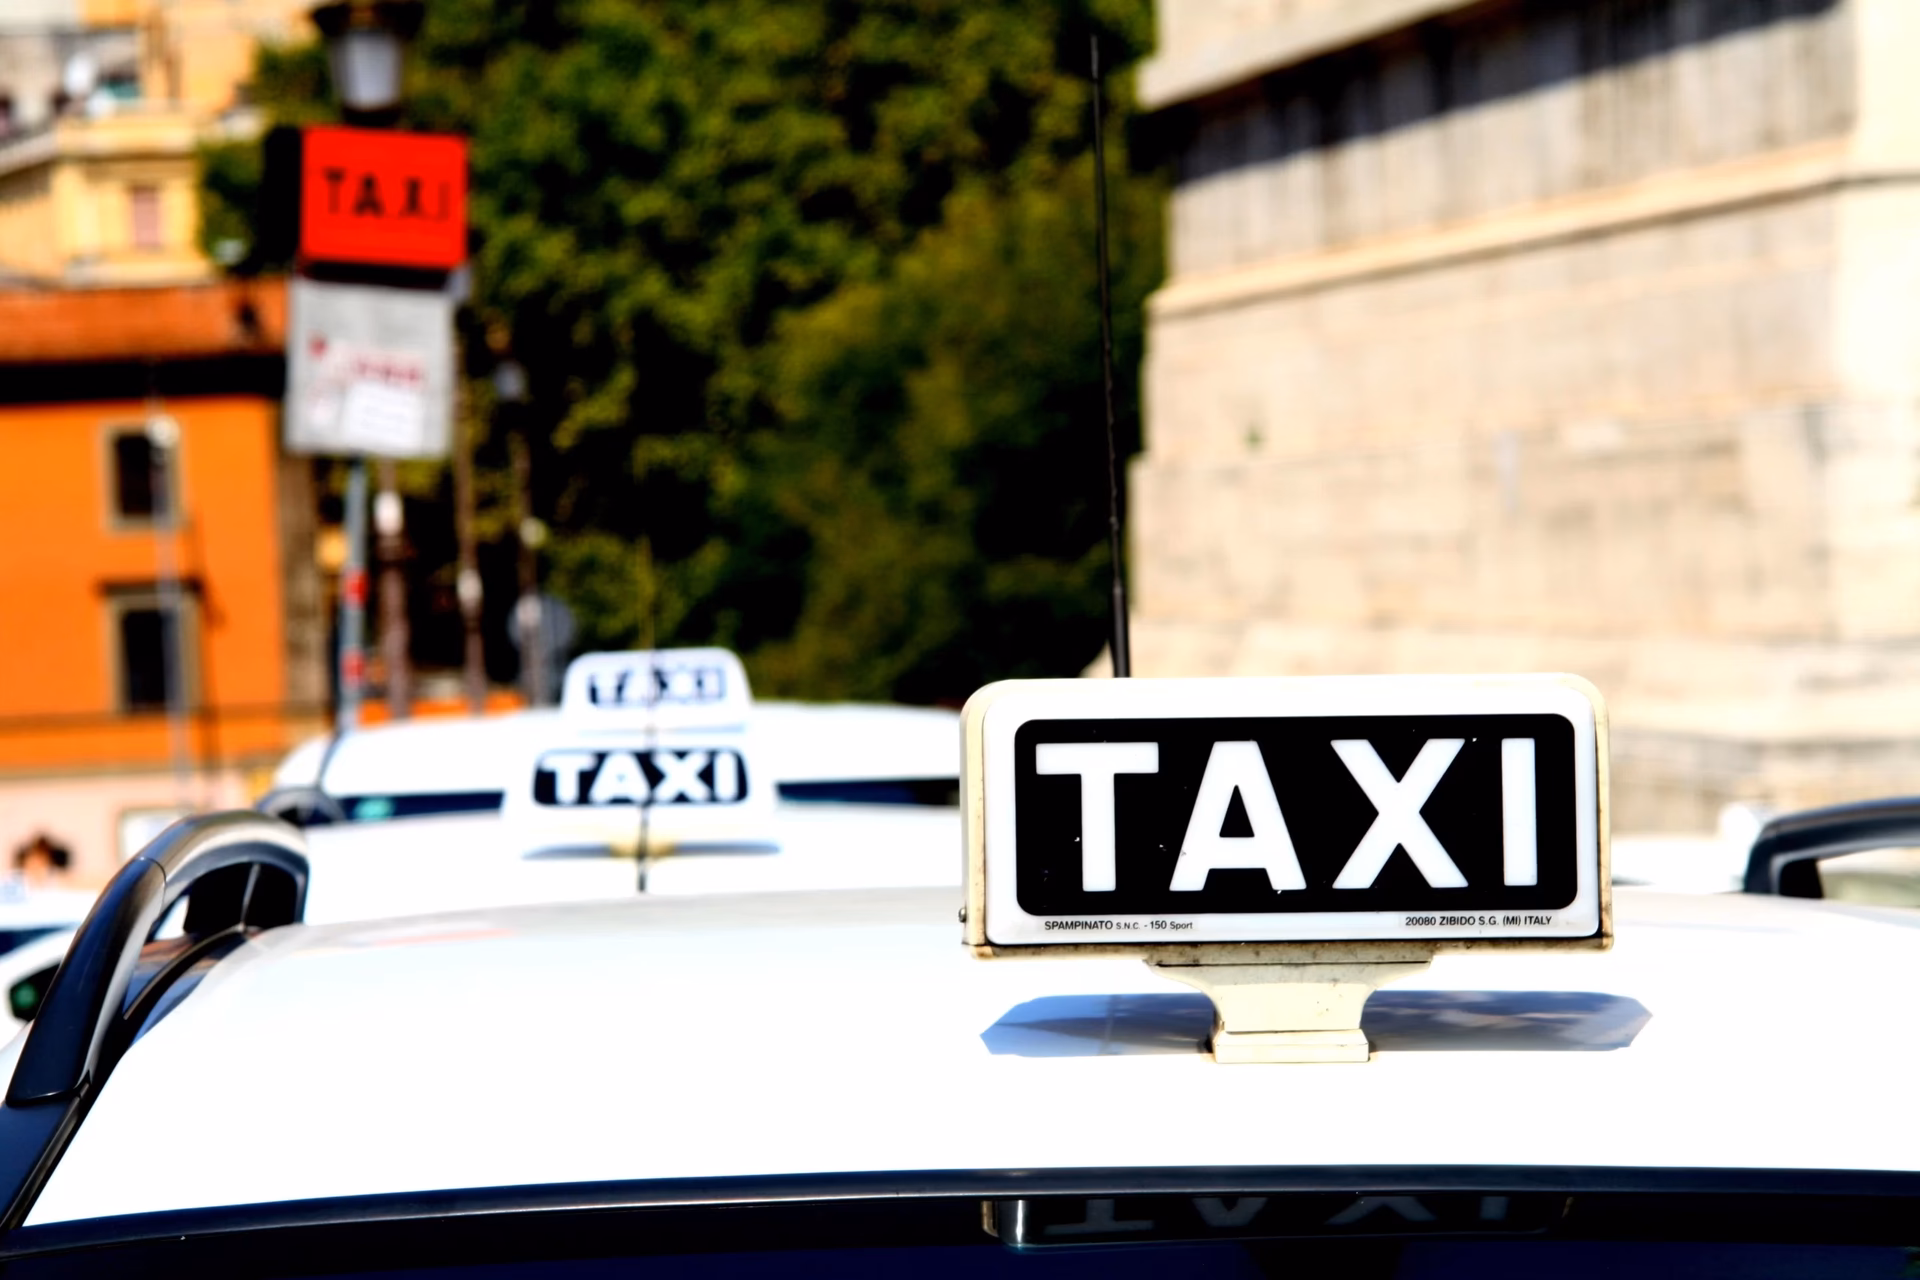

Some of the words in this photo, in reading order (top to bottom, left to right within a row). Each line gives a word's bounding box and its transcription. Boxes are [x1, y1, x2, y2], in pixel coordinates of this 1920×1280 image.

[541, 750, 738, 804] TAXI
[1035, 738, 1538, 892] TAXI
[1044, 920, 1113, 931] SPAMPINATO
[1116, 921, 1140, 930] S.N.C.
[1150, 920, 1167, 930] 150
[1169, 920, 1193, 931] Sport
[1405, 916, 1436, 926] 20080
[1439, 916, 1476, 926] ZIBIDO
[1478, 915, 1499, 926] S.G.
[1503, 915, 1521, 927] (MI)
[1524, 915, 1553, 925] ITALY
